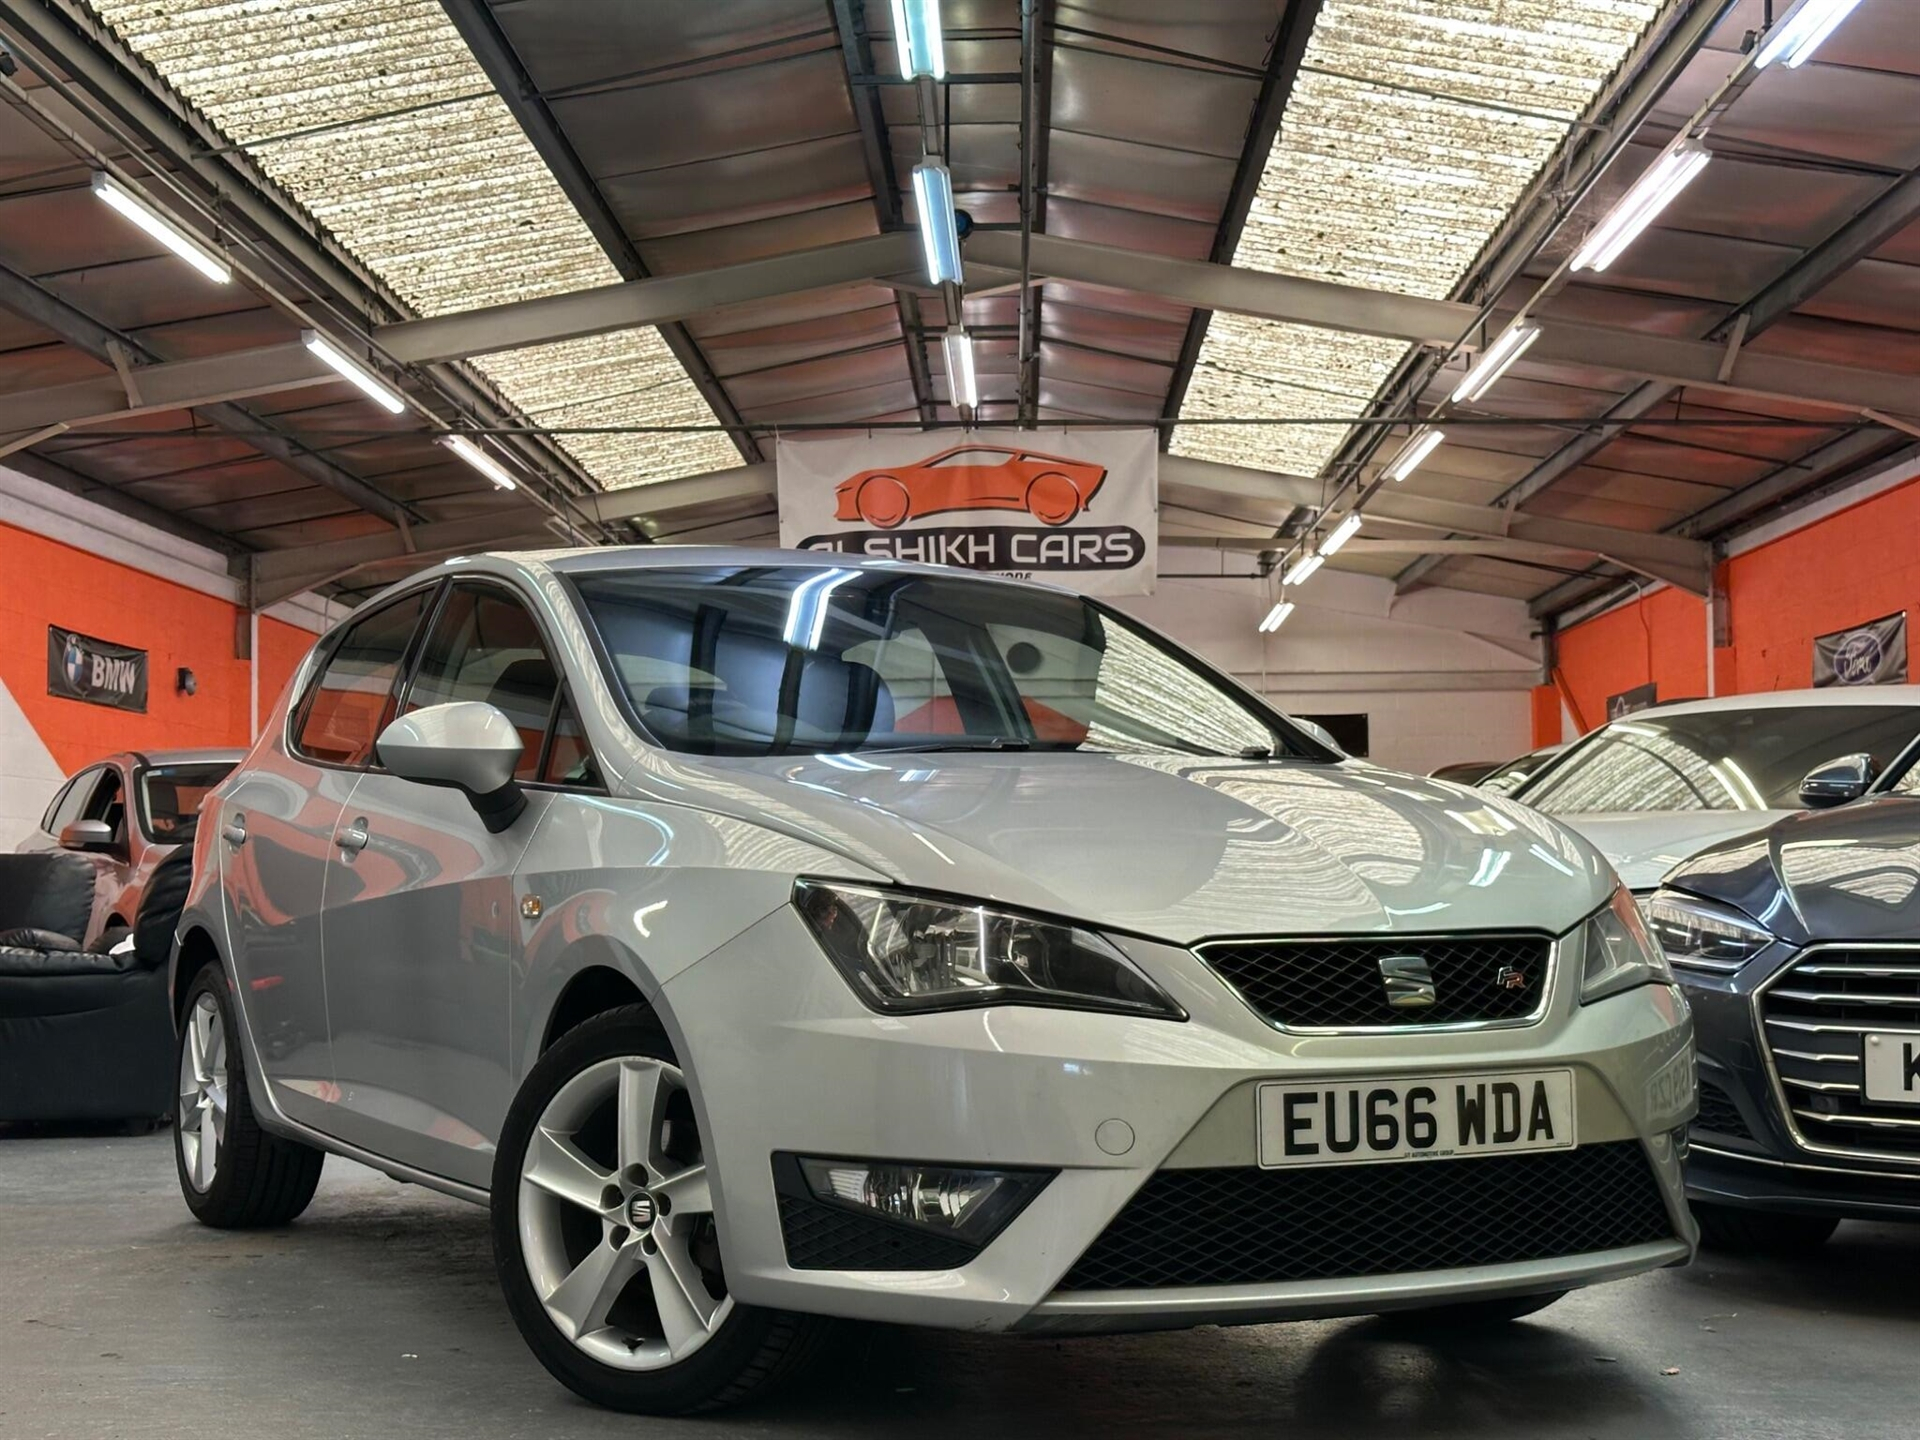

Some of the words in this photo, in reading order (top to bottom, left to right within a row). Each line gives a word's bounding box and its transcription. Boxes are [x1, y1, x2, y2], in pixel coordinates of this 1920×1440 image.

[864, 533, 995, 564] SHIKH
[1011, 533, 1133, 564] CARS
[91, 653, 135, 694] BMW
[1283, 1086, 1438, 1156] EU66
[1456, 1080, 1554, 1145] WDA
